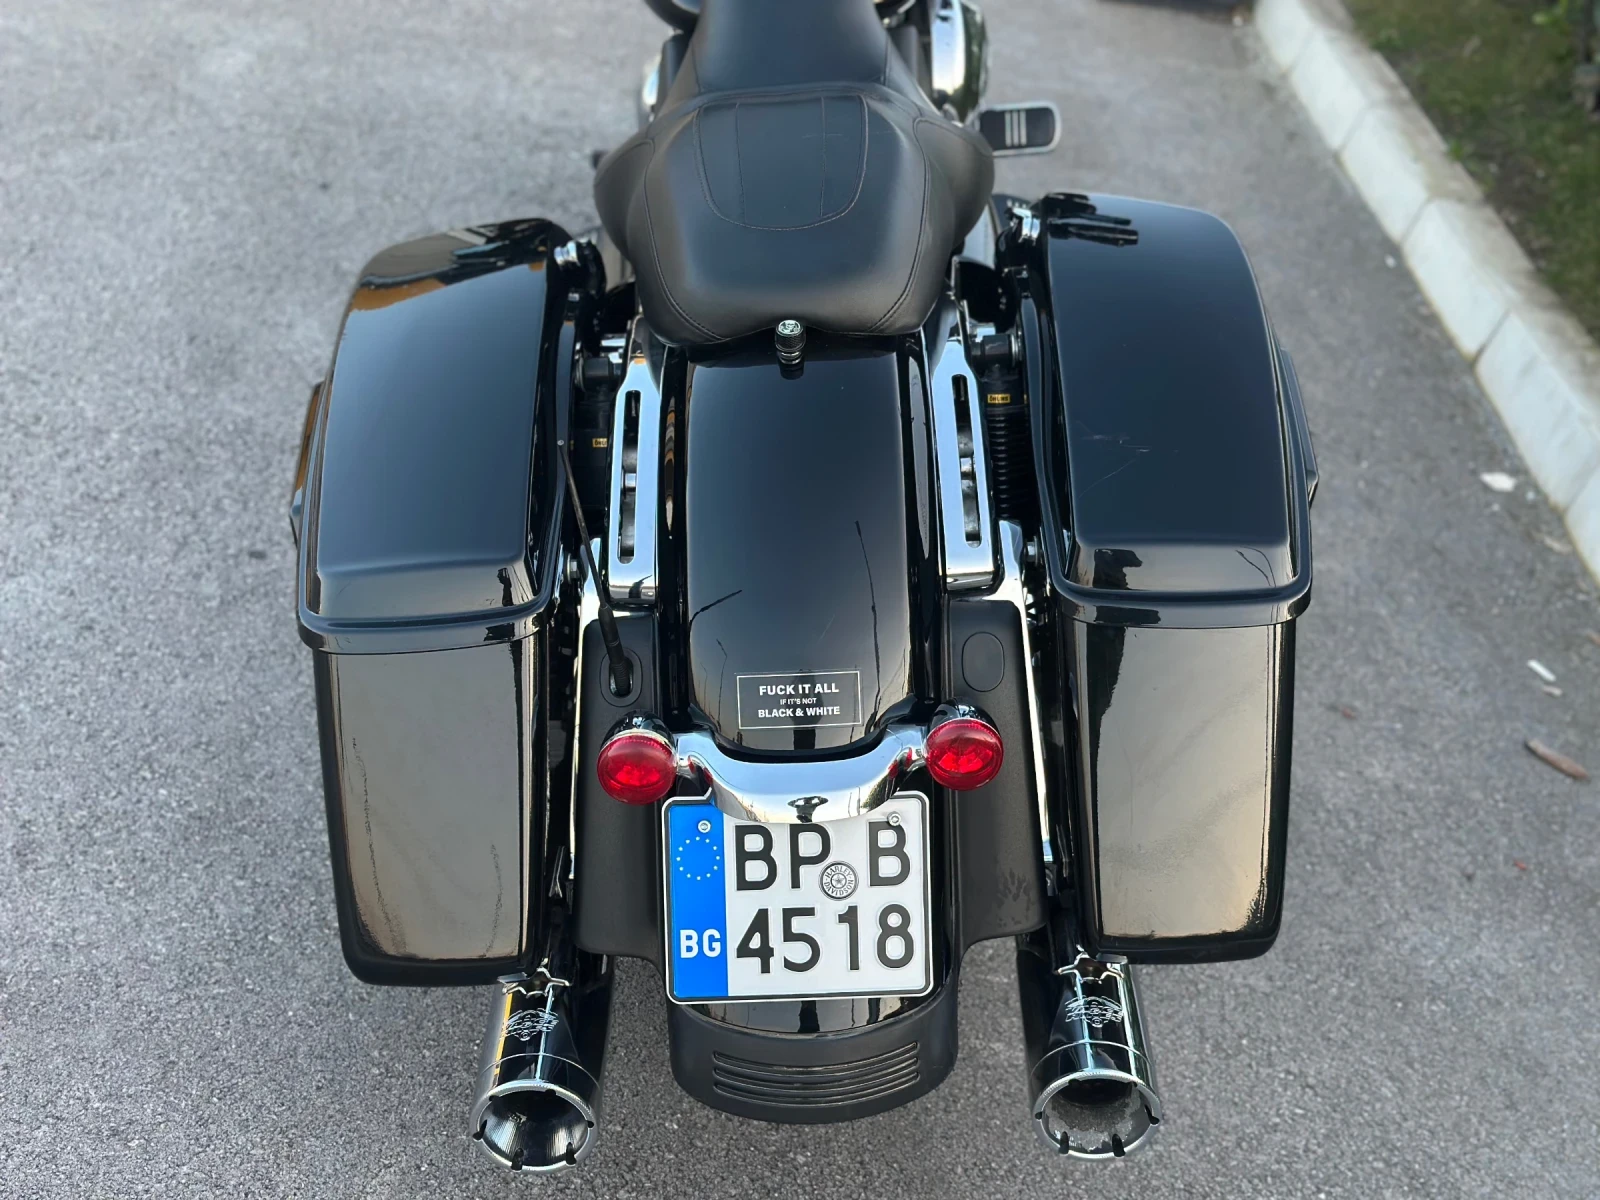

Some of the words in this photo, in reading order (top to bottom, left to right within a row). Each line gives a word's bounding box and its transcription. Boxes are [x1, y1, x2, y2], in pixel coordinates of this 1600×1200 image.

[759, 684, 796, 696] FUCK
[799, 683, 811, 694] IT
[814, 682, 840, 694] ALL
[780, 698, 787, 706] IF
[802, 697, 818, 705] NOT
[758, 708, 794, 718] BLACK
[795, 707, 804, 717] &
[806, 705, 841, 716] WHITE
[825, 865, 853, 879] HARLEY
[823, 879, 855, 896] DAVIDSON
[680, 928, 721, 958] BG
[736, 903, 914, 974] 4518
